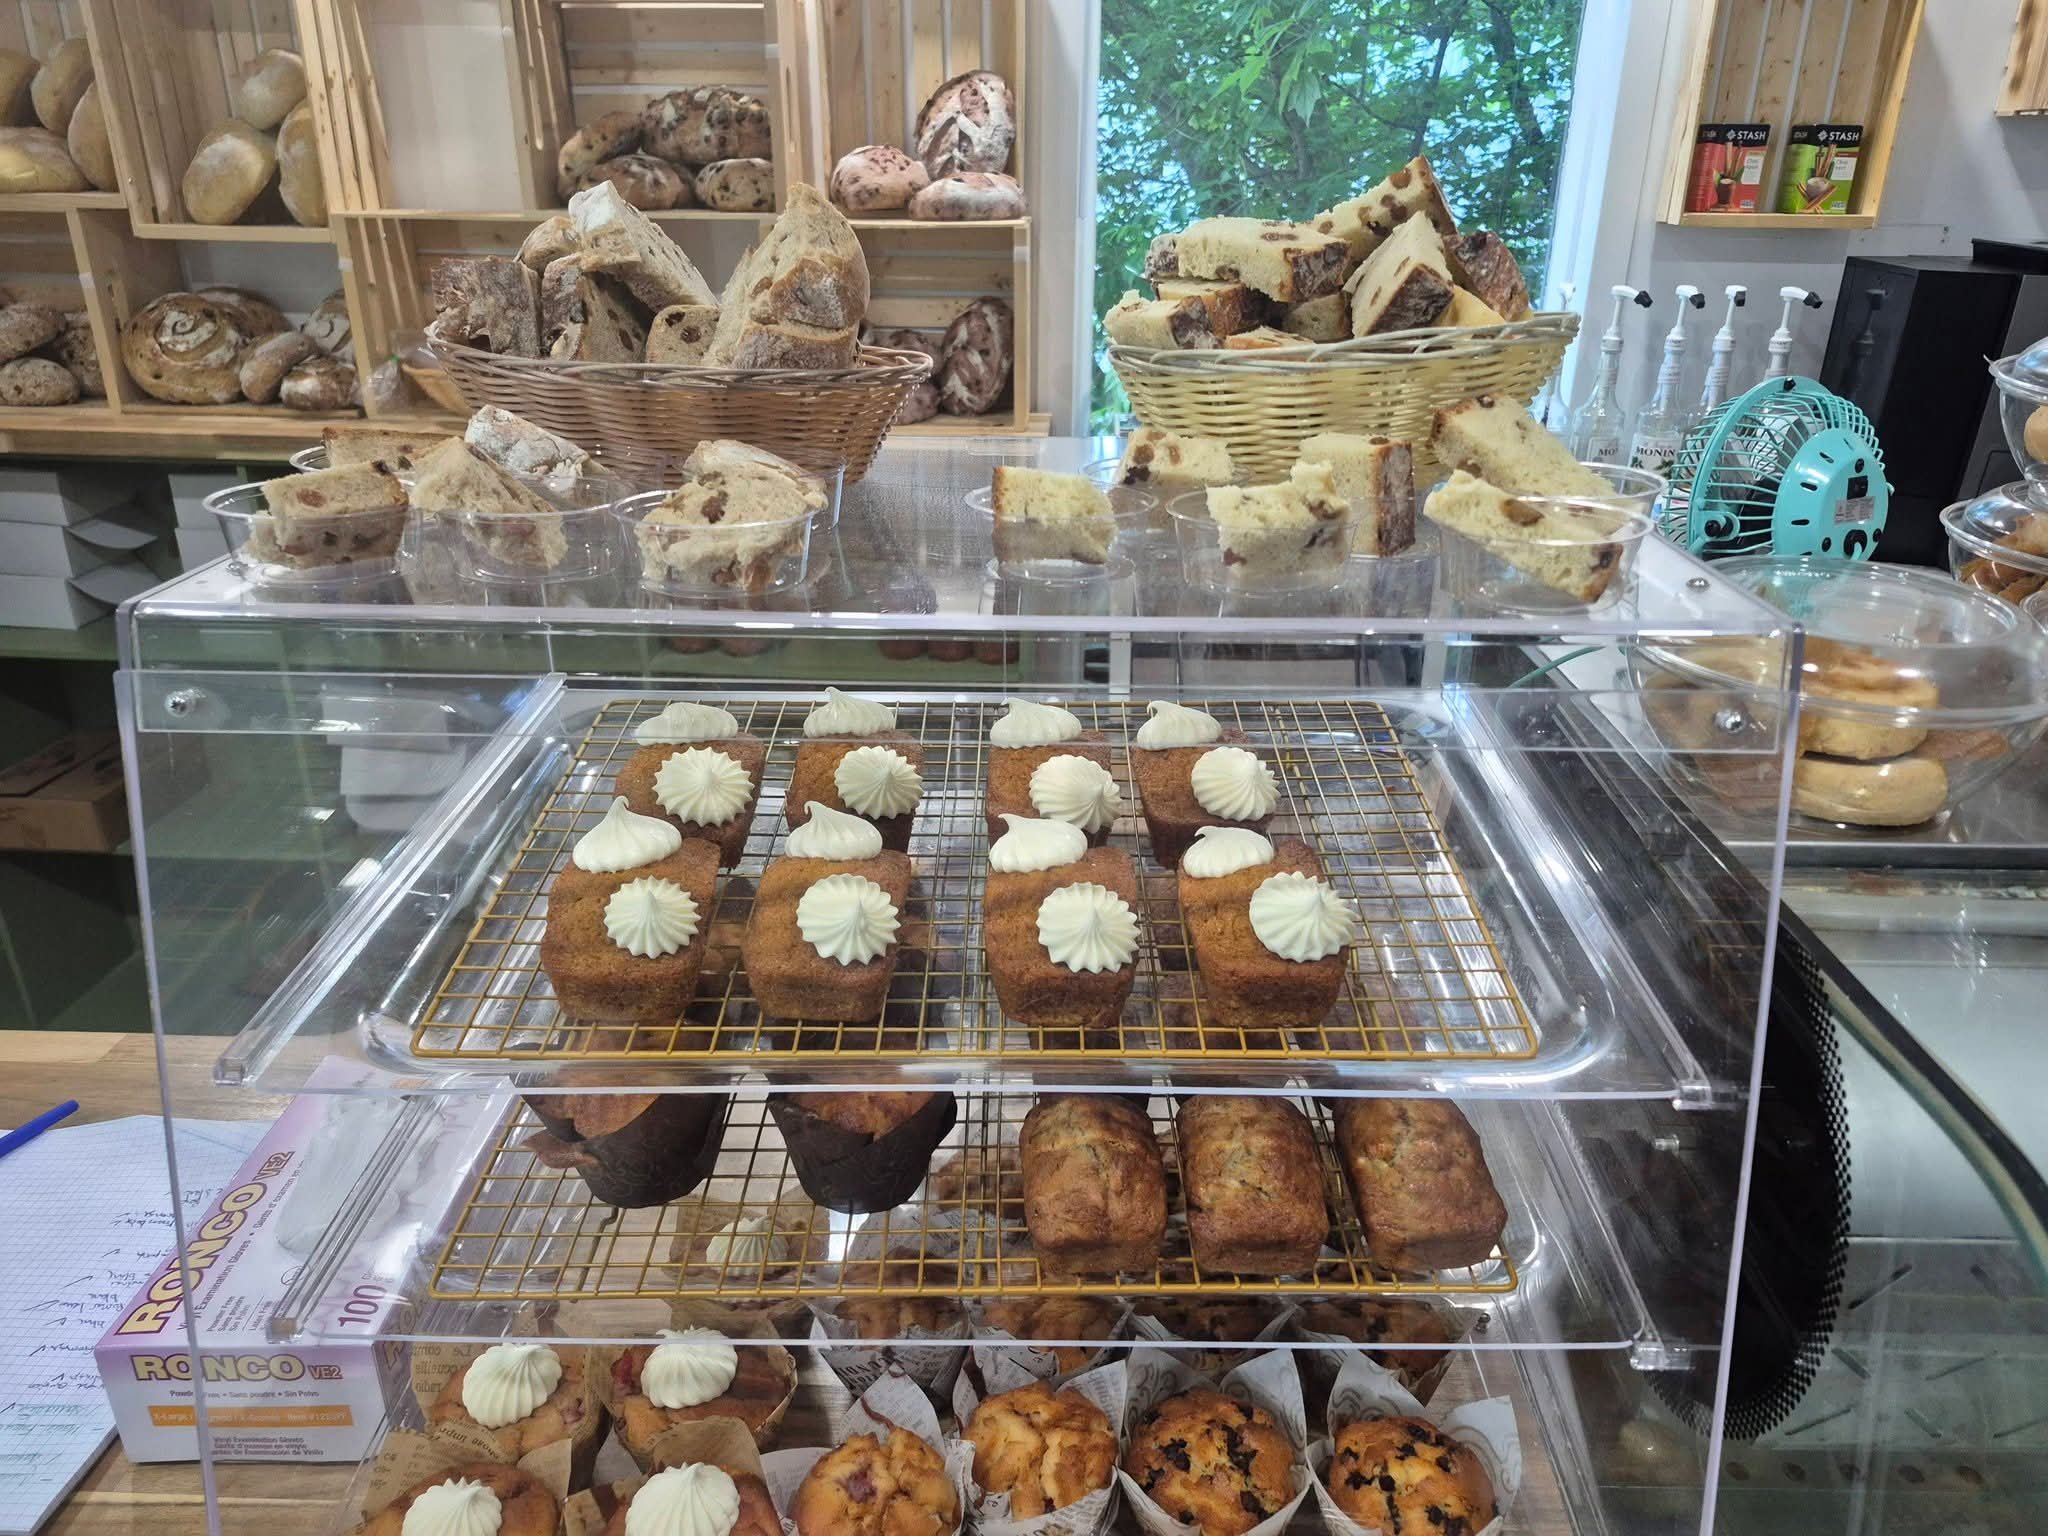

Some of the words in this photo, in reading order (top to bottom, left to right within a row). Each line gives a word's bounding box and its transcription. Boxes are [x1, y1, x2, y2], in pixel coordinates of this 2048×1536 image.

[1737, 131, 1767, 141] STASH
[1828, 131, 1860, 141] STASH
[1636, 446, 1677, 457] MONIN
[114, 1181, 268, 1336] RONCO
[252, 1150, 296, 1182] VE2
[195, 1263, 235, 1310] Examination
[227, 1239, 252, 1264] Gloves
[337, 1284, 387, 1328] 100
[131, 1353, 306, 1382] RONCO
[308, 1364, 343, 1380] VE2
